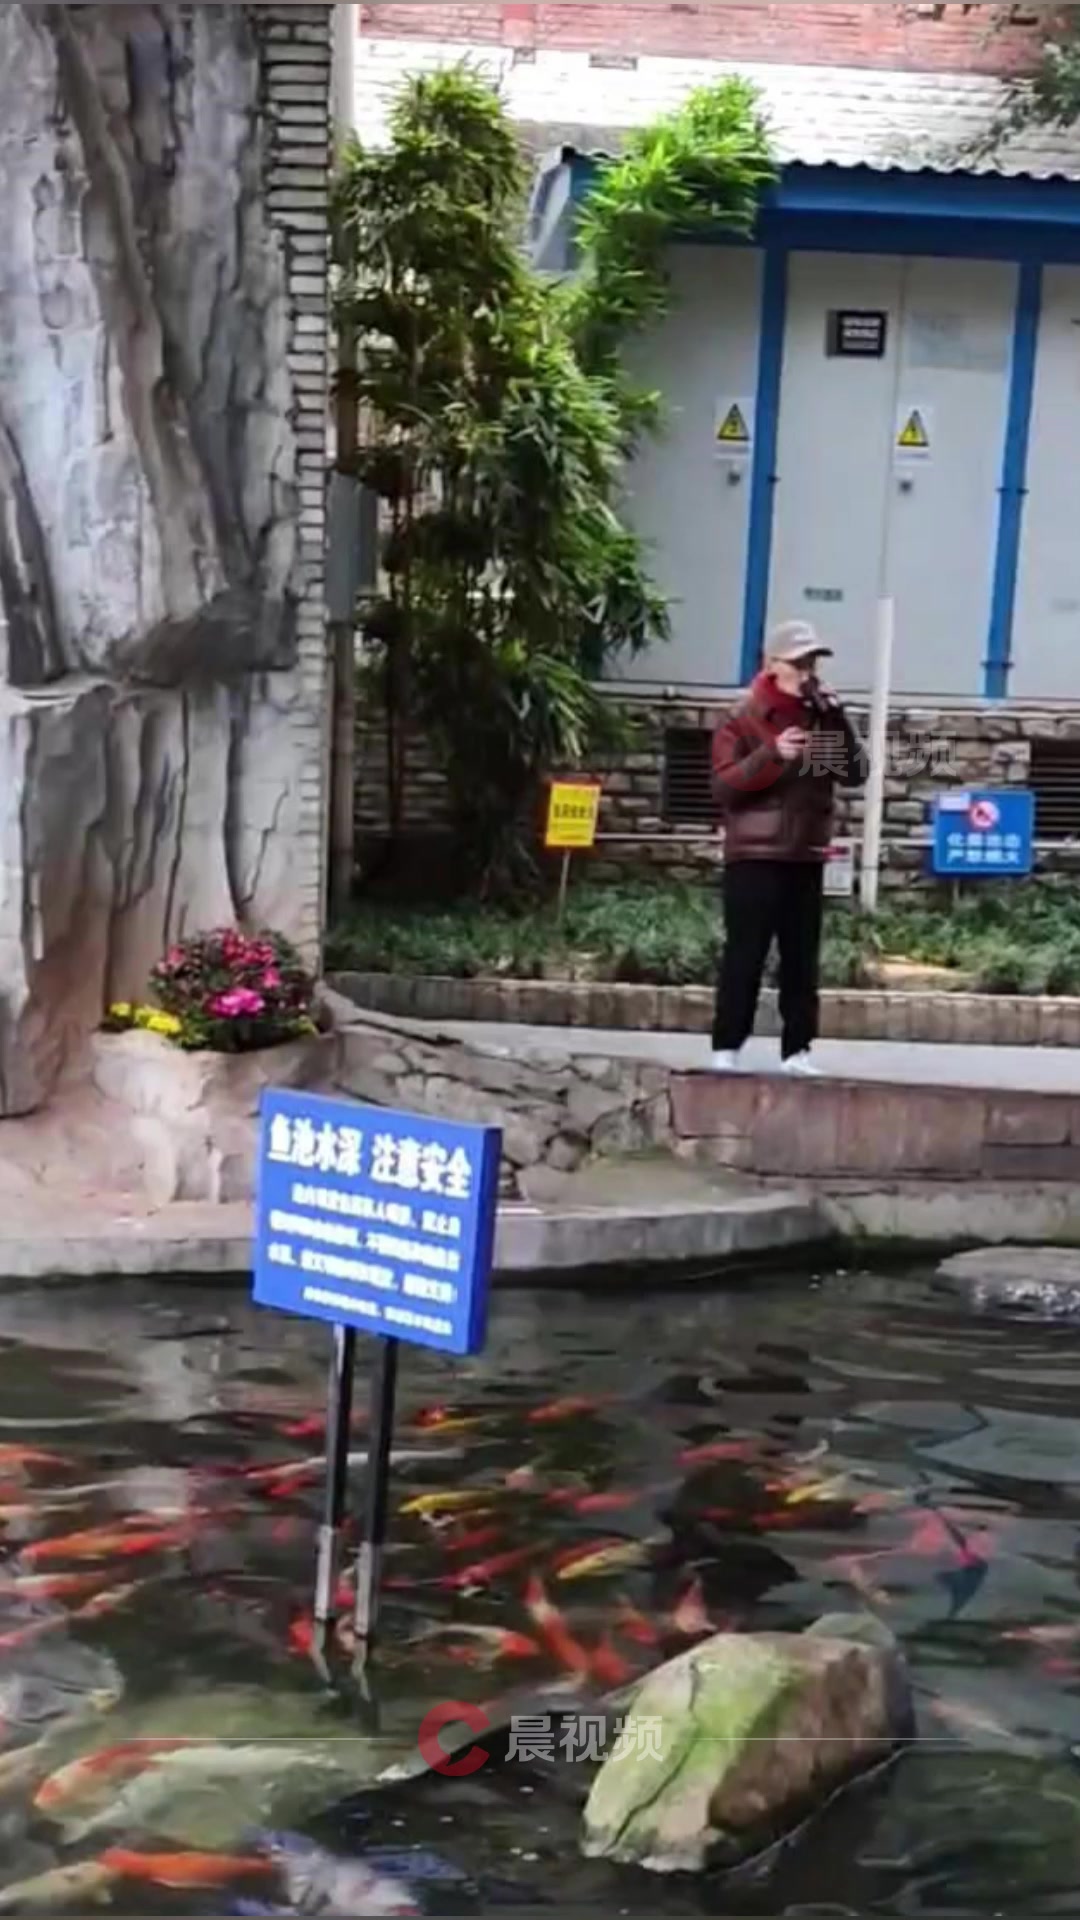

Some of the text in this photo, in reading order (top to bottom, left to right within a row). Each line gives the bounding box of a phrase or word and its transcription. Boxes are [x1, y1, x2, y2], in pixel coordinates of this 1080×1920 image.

[267, 1113, 473, 1198] 鱼池水深 注意安全
